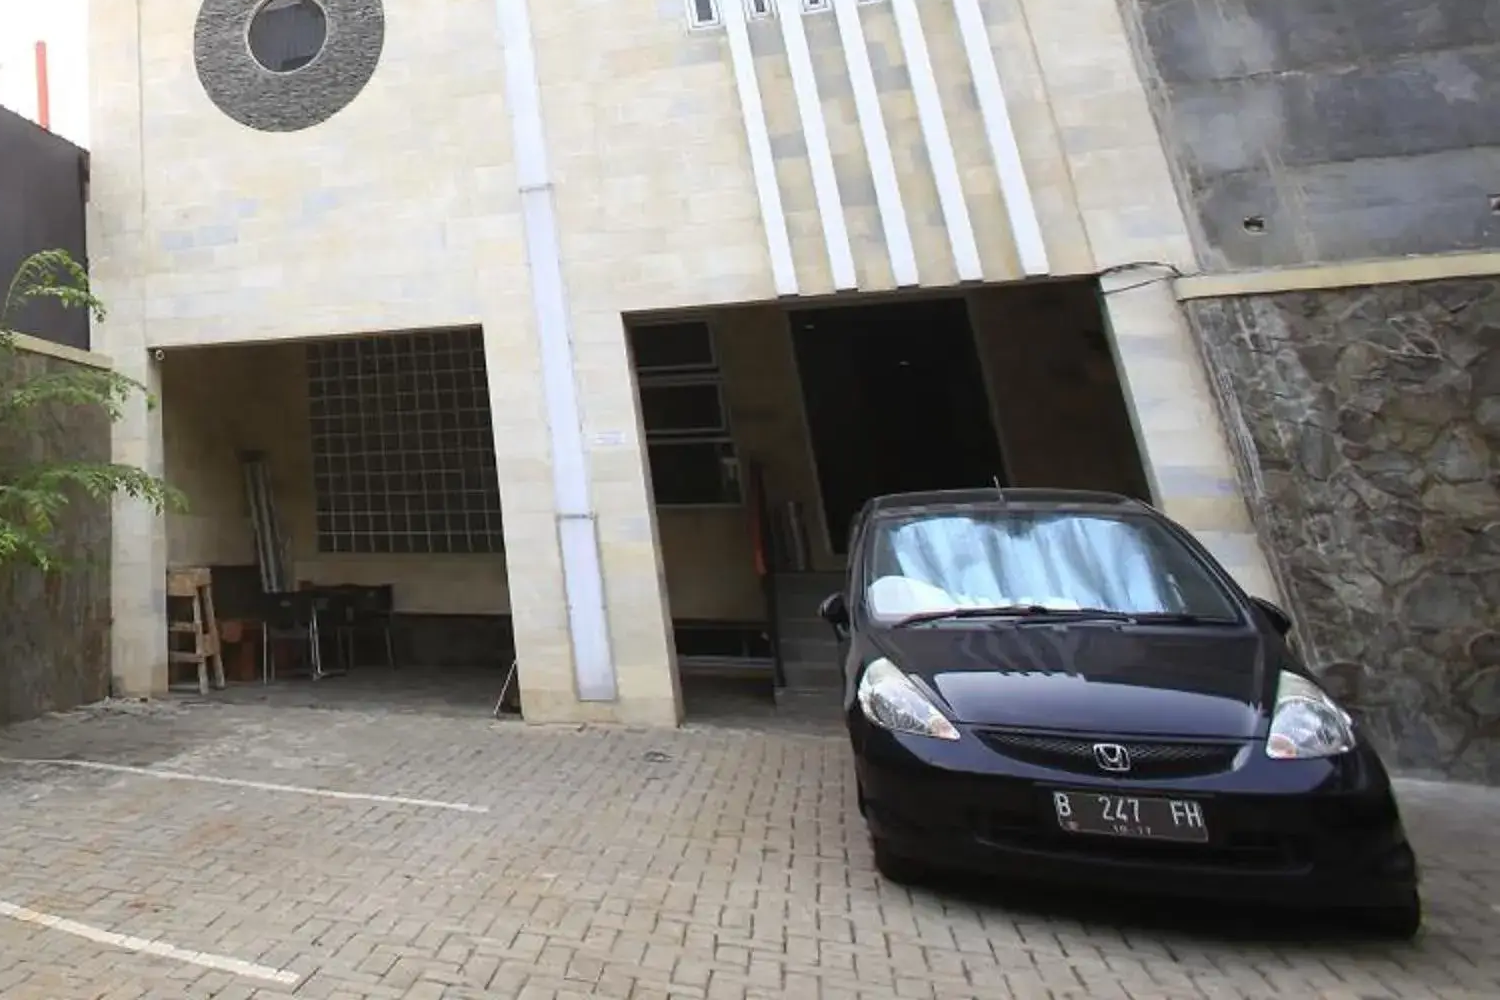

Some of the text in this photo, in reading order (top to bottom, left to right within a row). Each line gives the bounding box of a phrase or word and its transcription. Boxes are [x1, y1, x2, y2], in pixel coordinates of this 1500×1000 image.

[1053, 791, 1203, 827] B 247 FH
